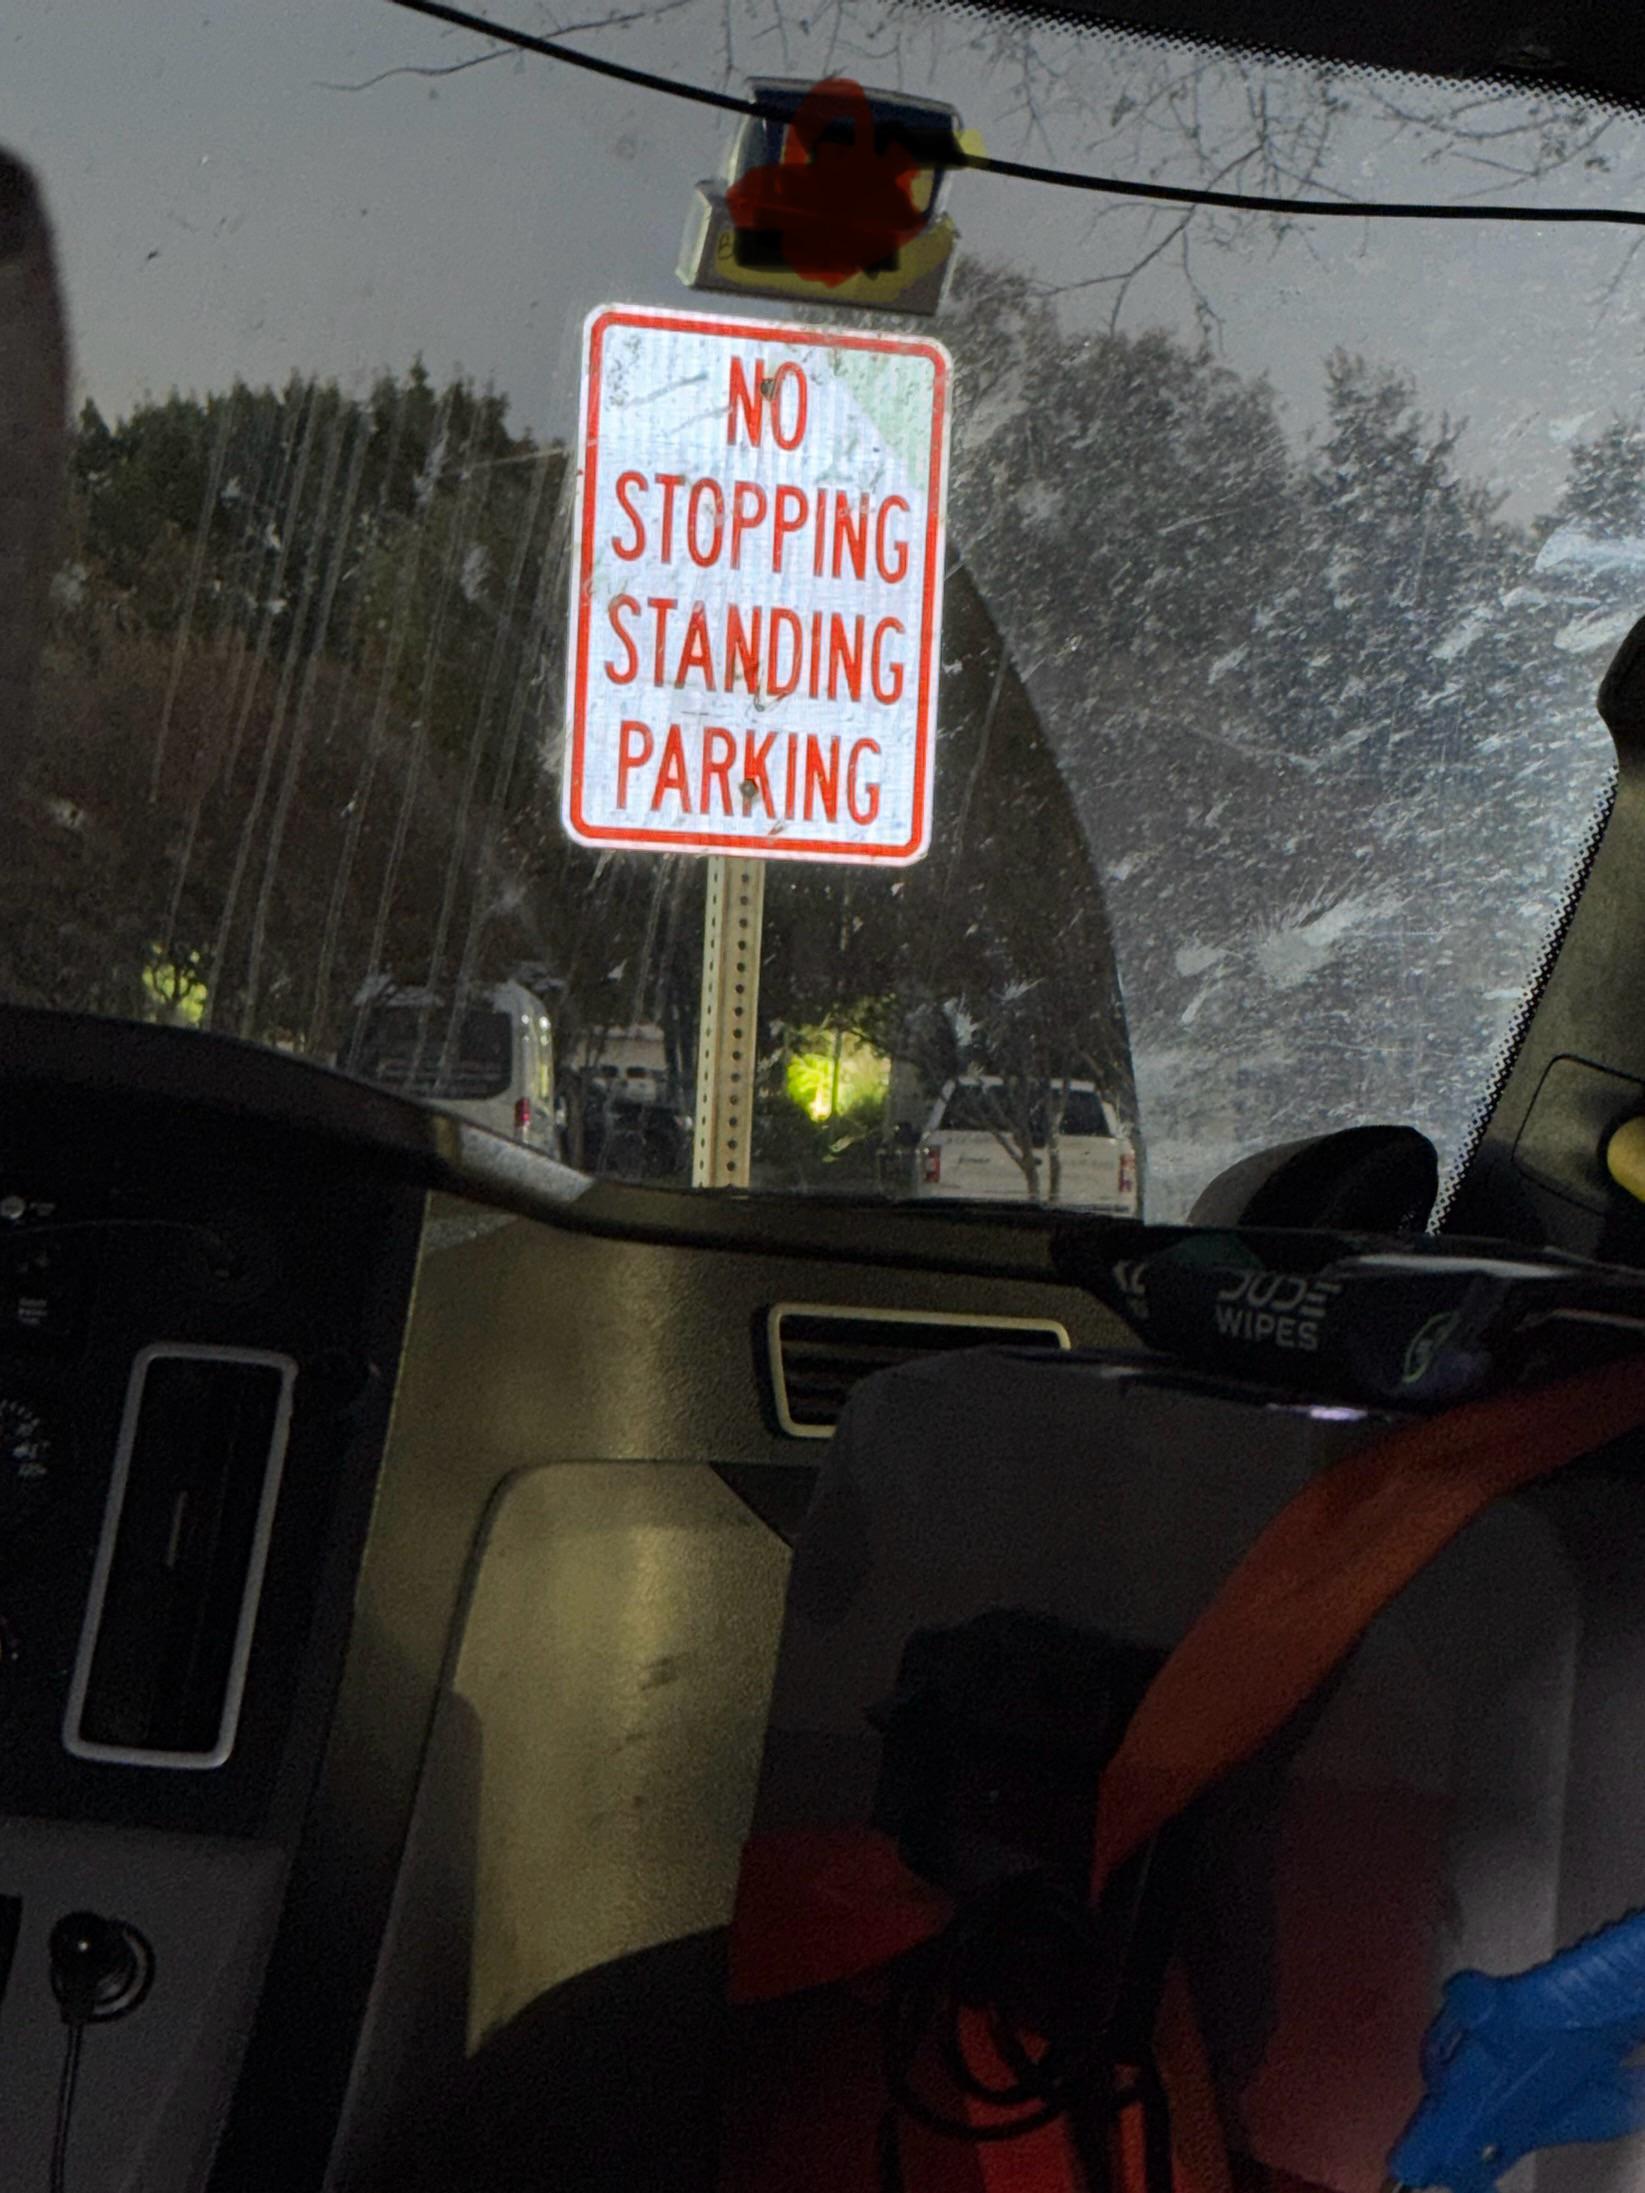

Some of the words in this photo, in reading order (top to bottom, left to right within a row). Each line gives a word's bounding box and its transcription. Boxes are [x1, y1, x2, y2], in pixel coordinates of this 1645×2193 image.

[727, 356, 808, 452] NO
[612, 471, 910, 585] STOPPING
[605, 594, 905, 705] STANDING
[617, 719, 881, 826] PARKING
[1215, 1303, 1319, 1351] WIPES
